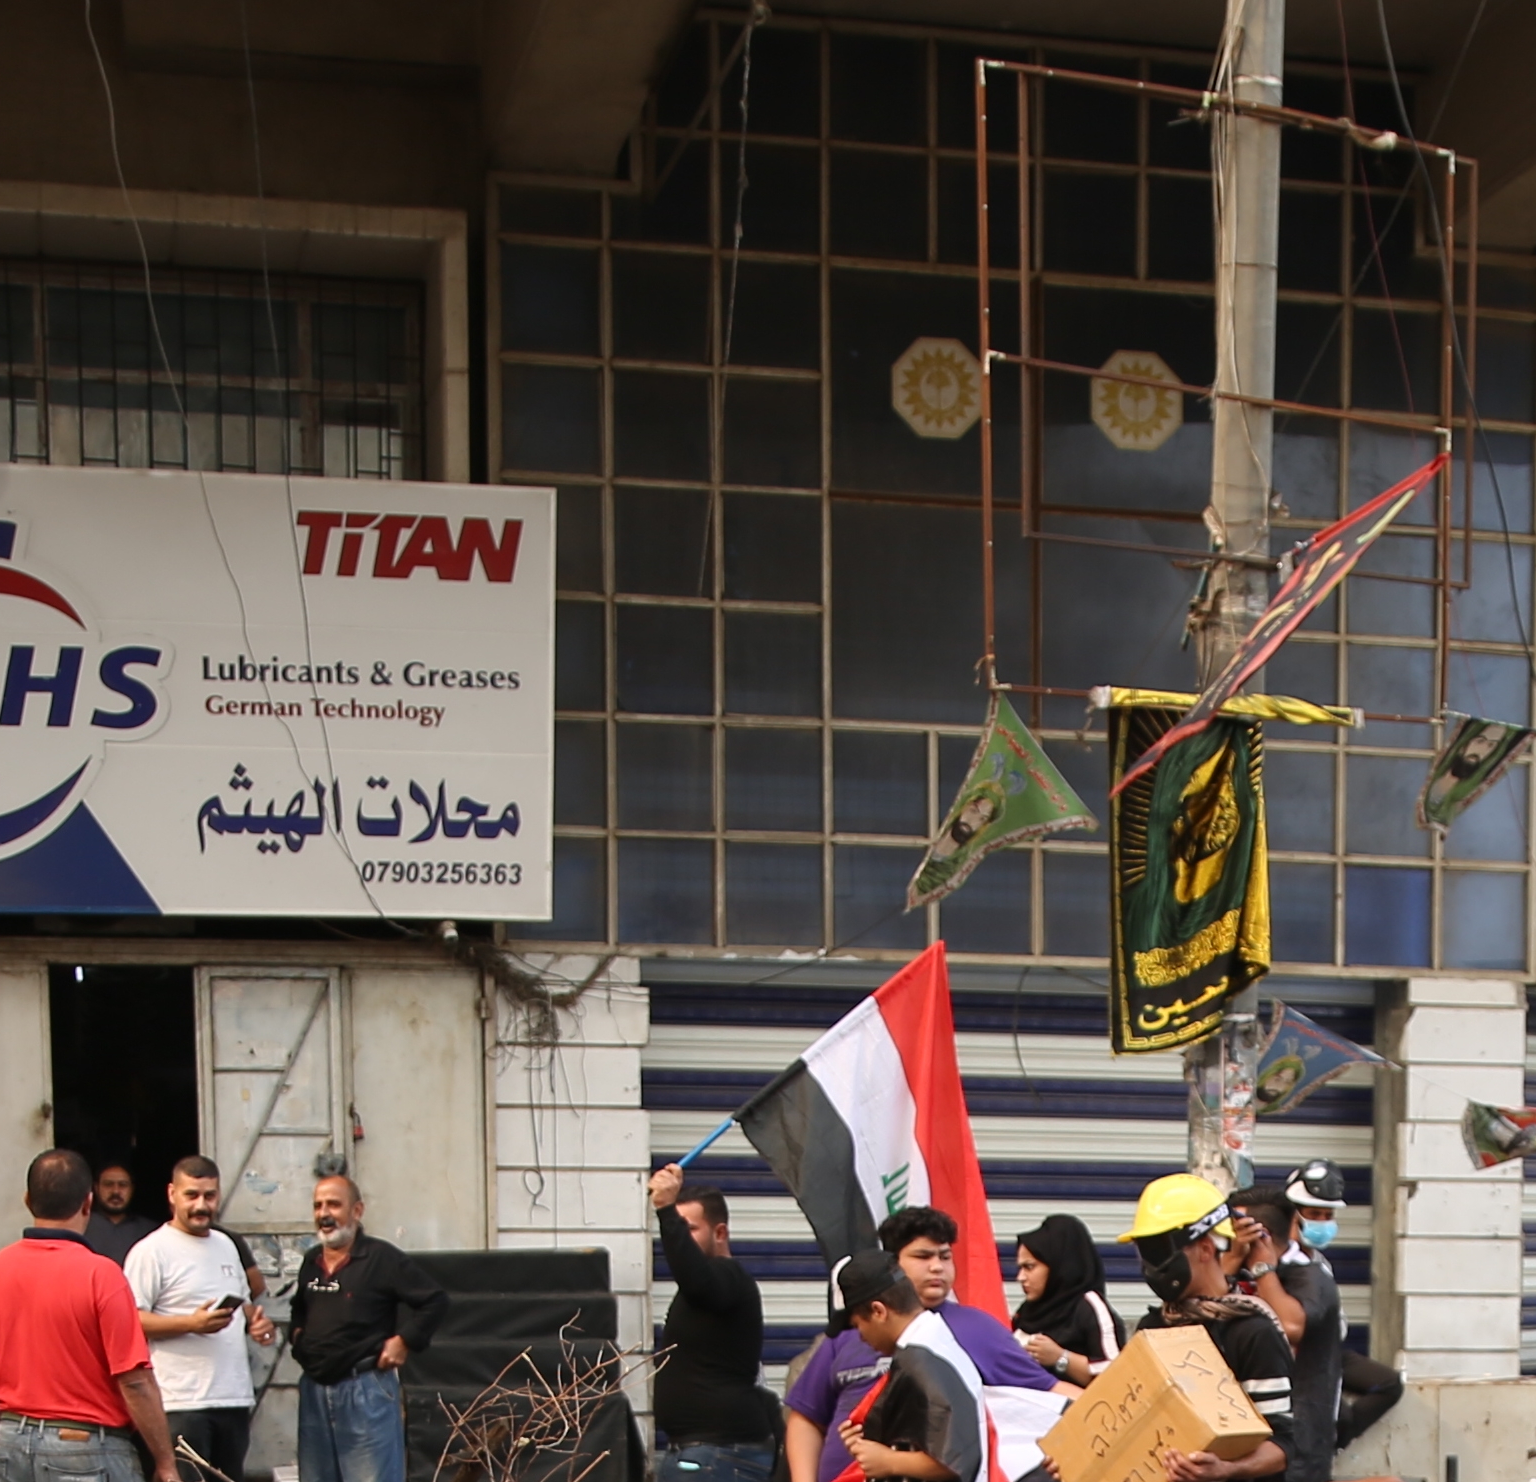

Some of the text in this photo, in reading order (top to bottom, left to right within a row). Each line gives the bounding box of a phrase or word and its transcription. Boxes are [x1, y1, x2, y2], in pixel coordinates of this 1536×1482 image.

[201, 655, 521, 690] Lubricants & Greases
[205, 695, 446, 728] German Technology
[197, 762, 521, 855] محلات الهيثم
[362, 861, 523, 885] 07903256363
